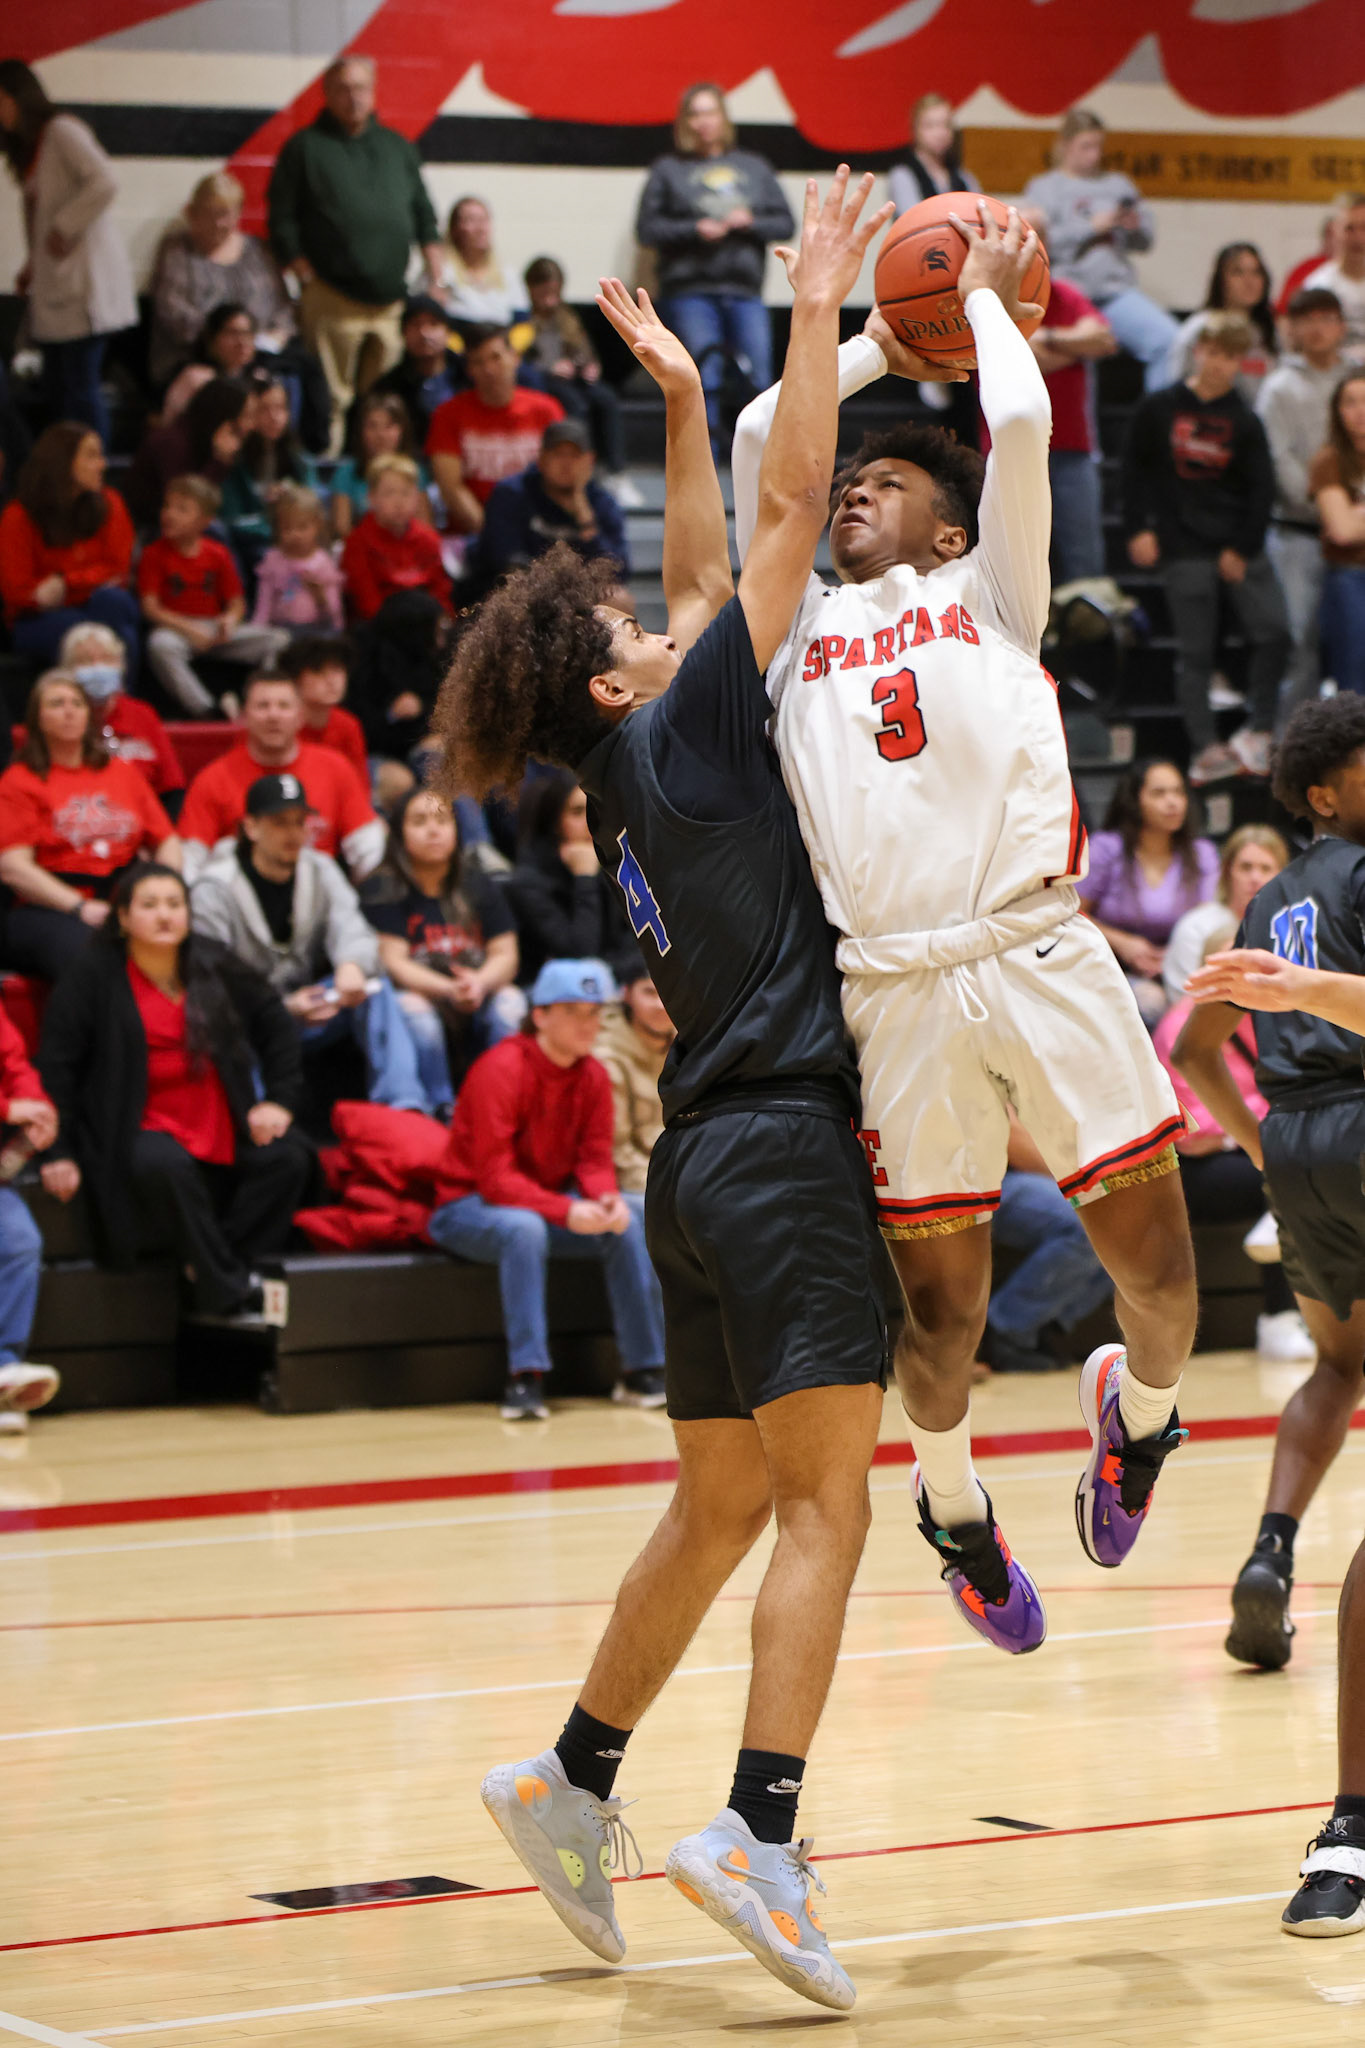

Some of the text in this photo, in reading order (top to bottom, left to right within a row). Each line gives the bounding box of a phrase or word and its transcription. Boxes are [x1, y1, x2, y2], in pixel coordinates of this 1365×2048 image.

[899, 315, 971, 340] SPALD
[802, 602, 980, 682] SPARTANS
[871, 667, 928, 762] 3
[616, 826, 672, 957] 4
